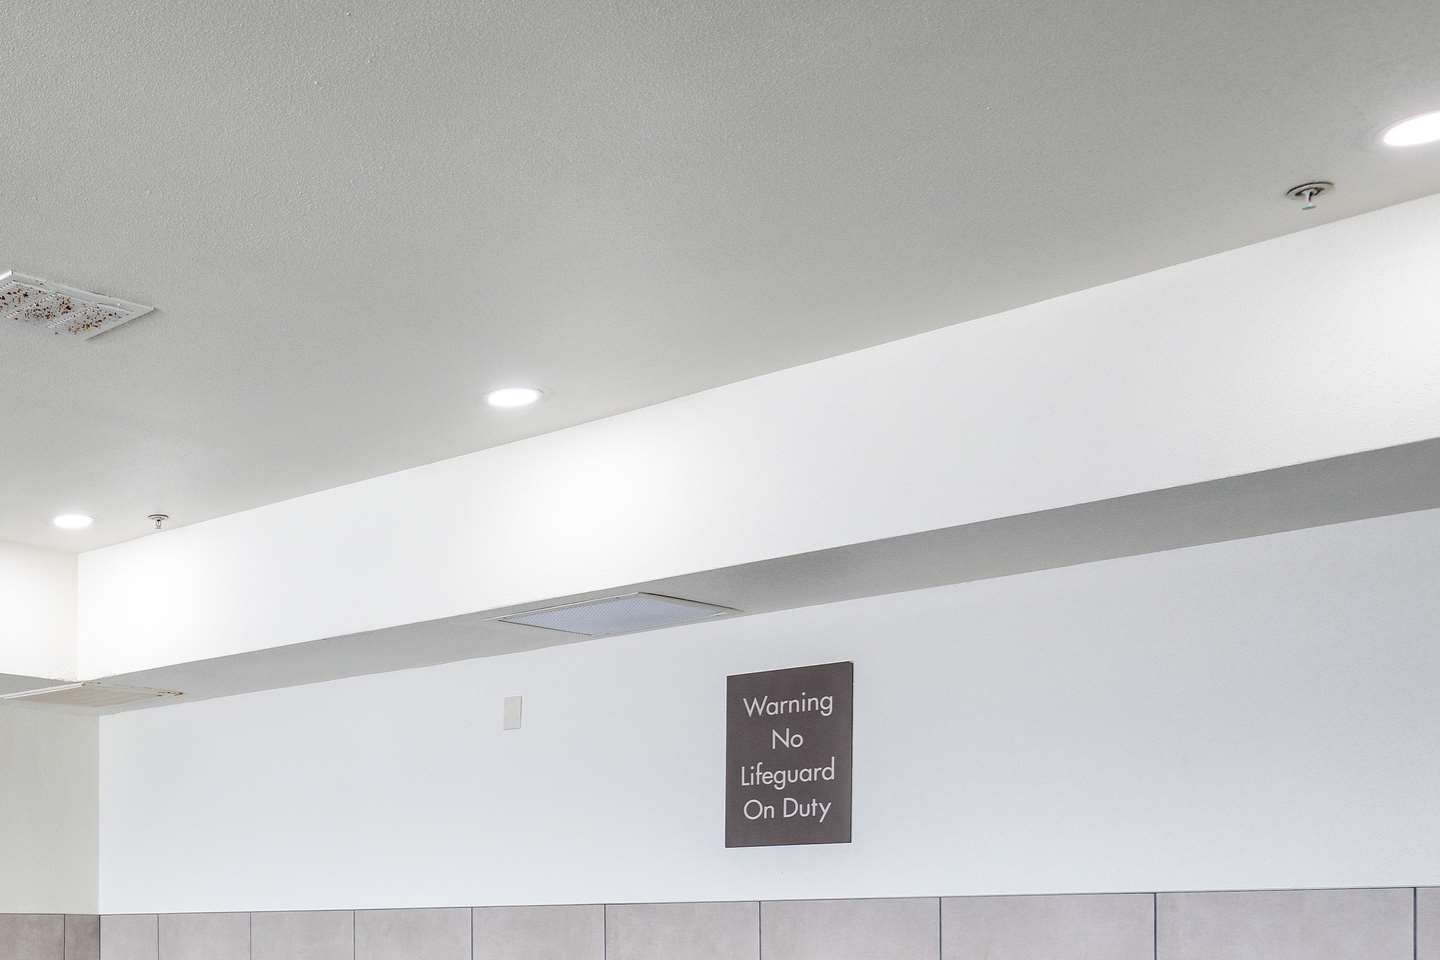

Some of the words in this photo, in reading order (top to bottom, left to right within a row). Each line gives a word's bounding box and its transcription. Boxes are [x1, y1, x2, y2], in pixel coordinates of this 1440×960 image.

[743, 692, 833, 717] Warning
[771, 728, 803, 749] No
[741, 756, 835, 790] Lifeguard
[743, 799, 775, 820] On
[783, 797, 832, 823] Duty
